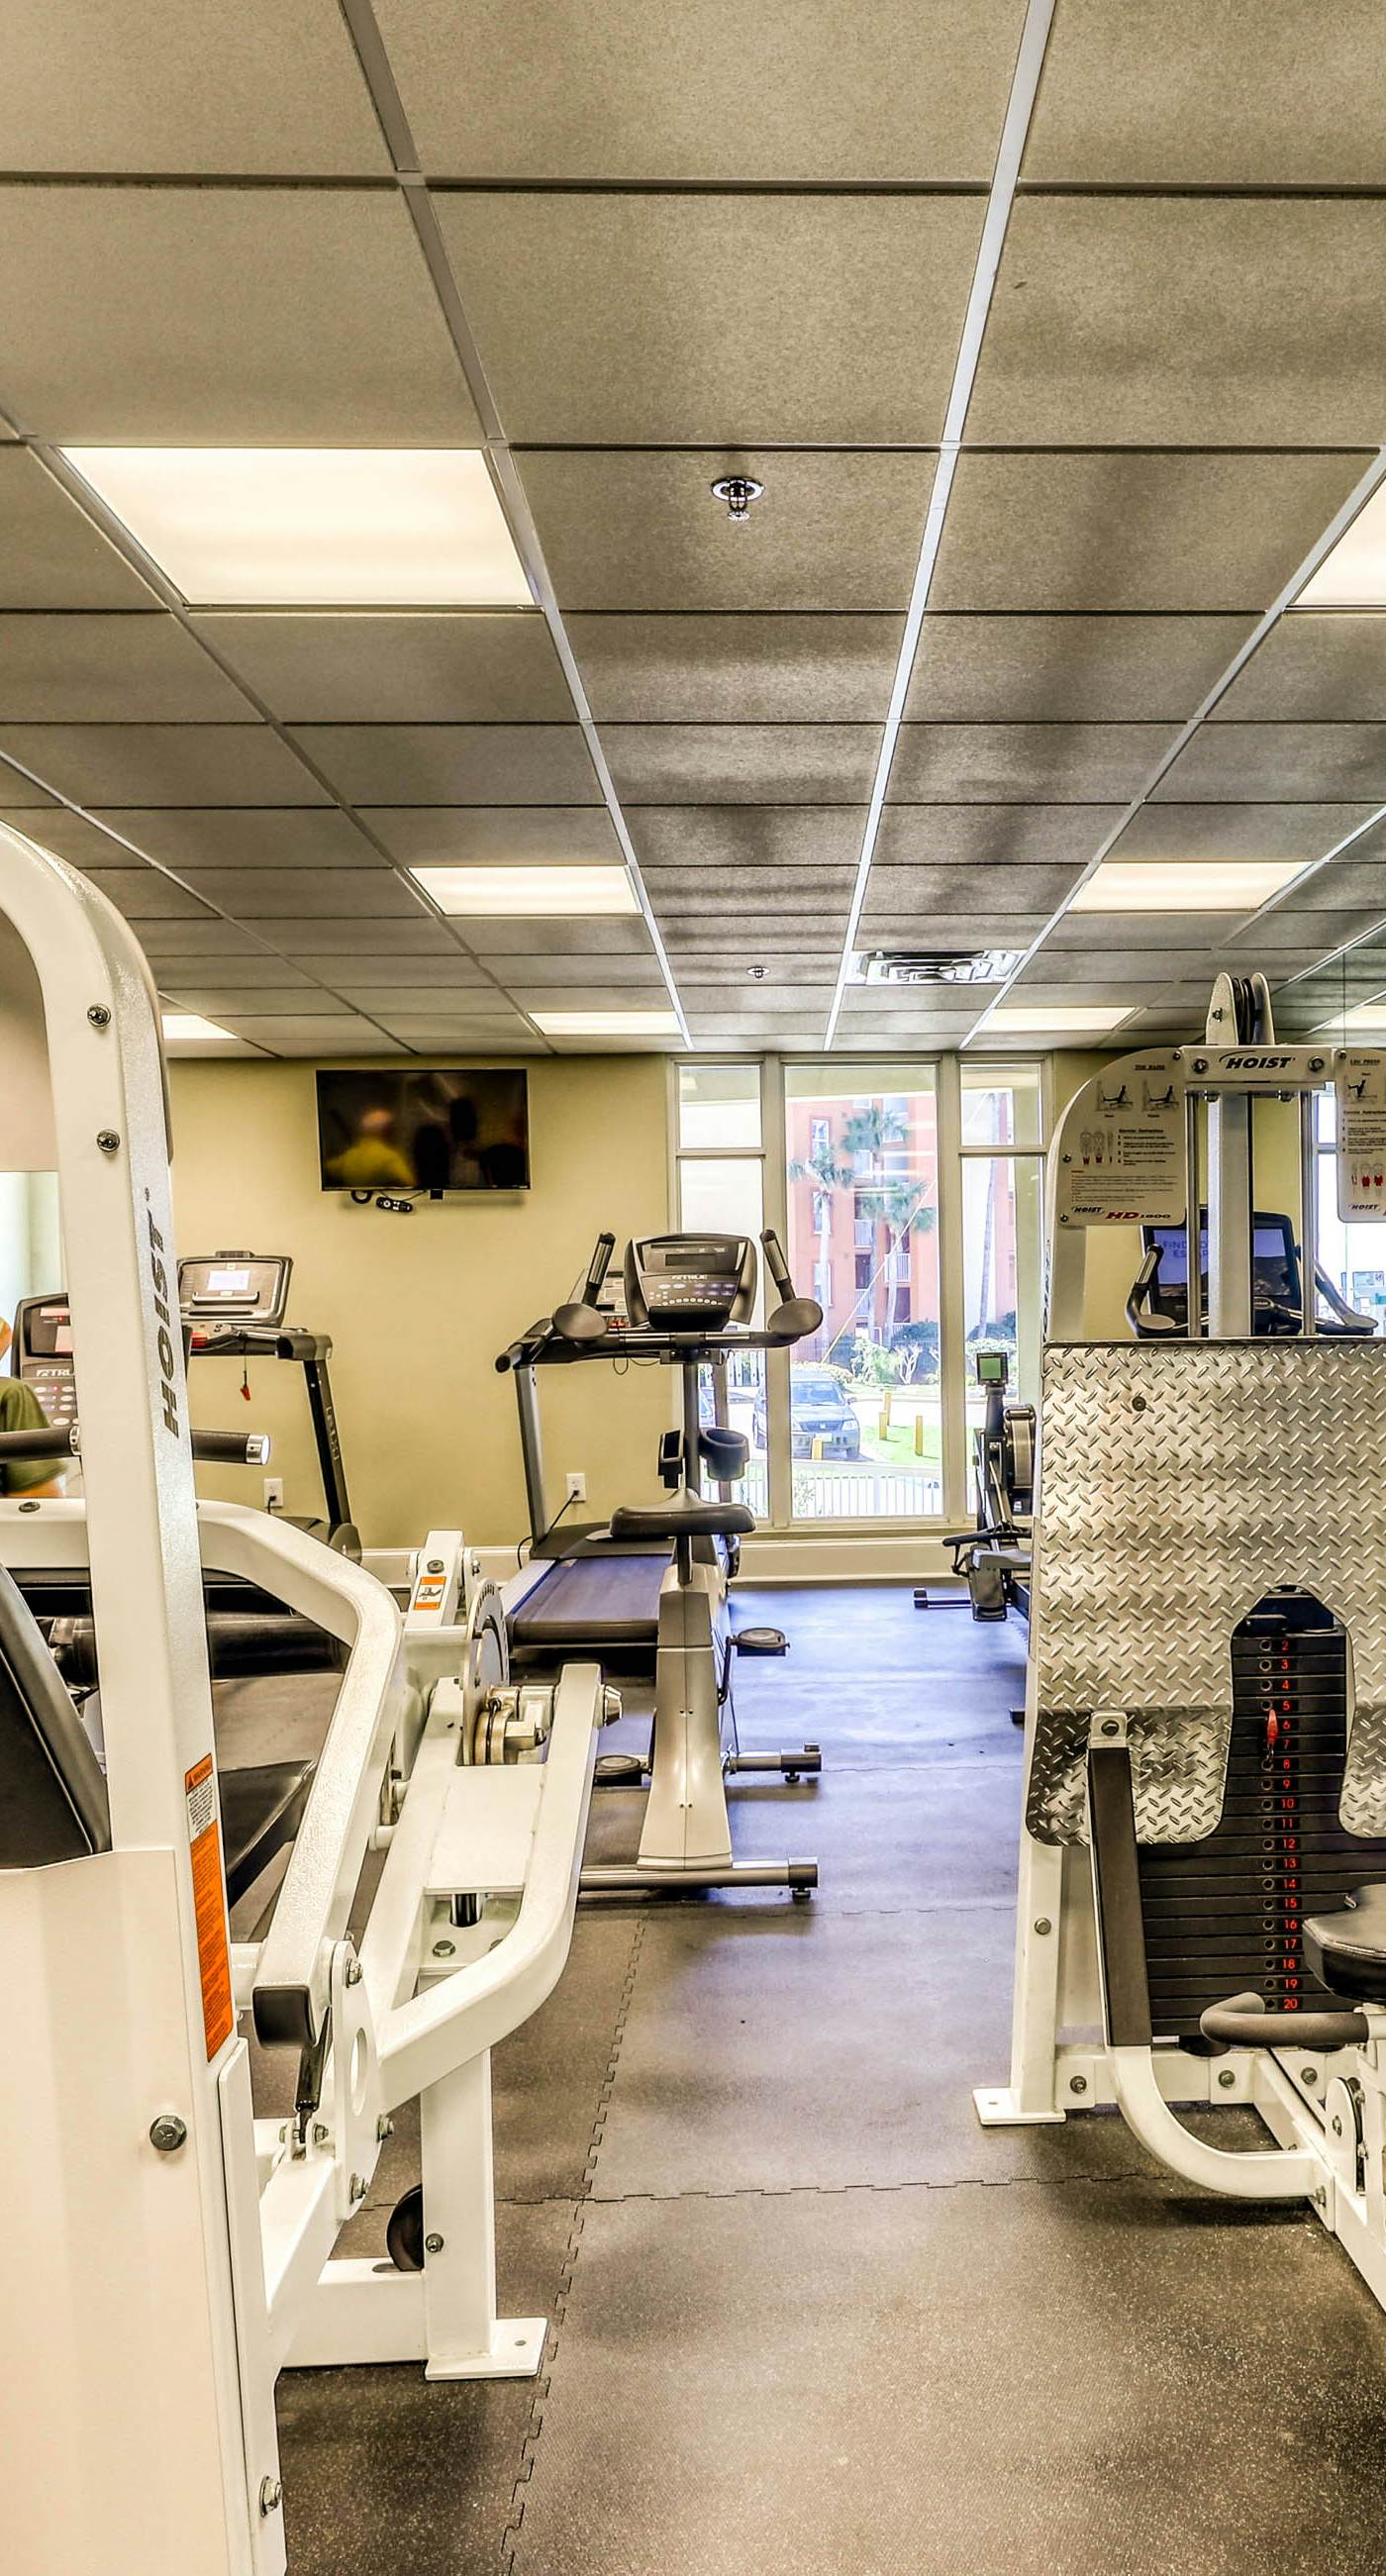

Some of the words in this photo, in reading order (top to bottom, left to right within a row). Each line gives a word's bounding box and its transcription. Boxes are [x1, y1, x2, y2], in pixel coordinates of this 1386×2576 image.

[1224, 1056, 1293, 1069] HOIST
[147, 1208, 179, 1438] HOIST
[1282, 1640, 1289, 1651] 2
[1282, 1659, 1289, 1670] 3
[1282, 1680, 1290, 1691] 4
[1283, 1700, 1291, 1711] 5
[1283, 1720, 1290, 1730] 6
[1283, 1738, 1290, 1749] 7
[1283, 1758, 1291, 1769] 8
[1283, 1778, 1291, 1789] 9
[1282, 1798, 1295, 1810] 10
[1283, 1818, 1294, 1829] 11
[1283, 1838, 1296, 1849] 12
[1283, 1857, 1297, 1869] 13
[1283, 1877, 1297, 1889] 14
[1284, 1897, 1298, 1909] 15
[1284, 1918, 1298, 1930] 16
[1284, 1937, 1298, 1949] 17
[1283, 1957, 1296, 1969] 18
[1284, 1977, 1299, 1989] 19
[1283, 1997, 1299, 2010] 20
